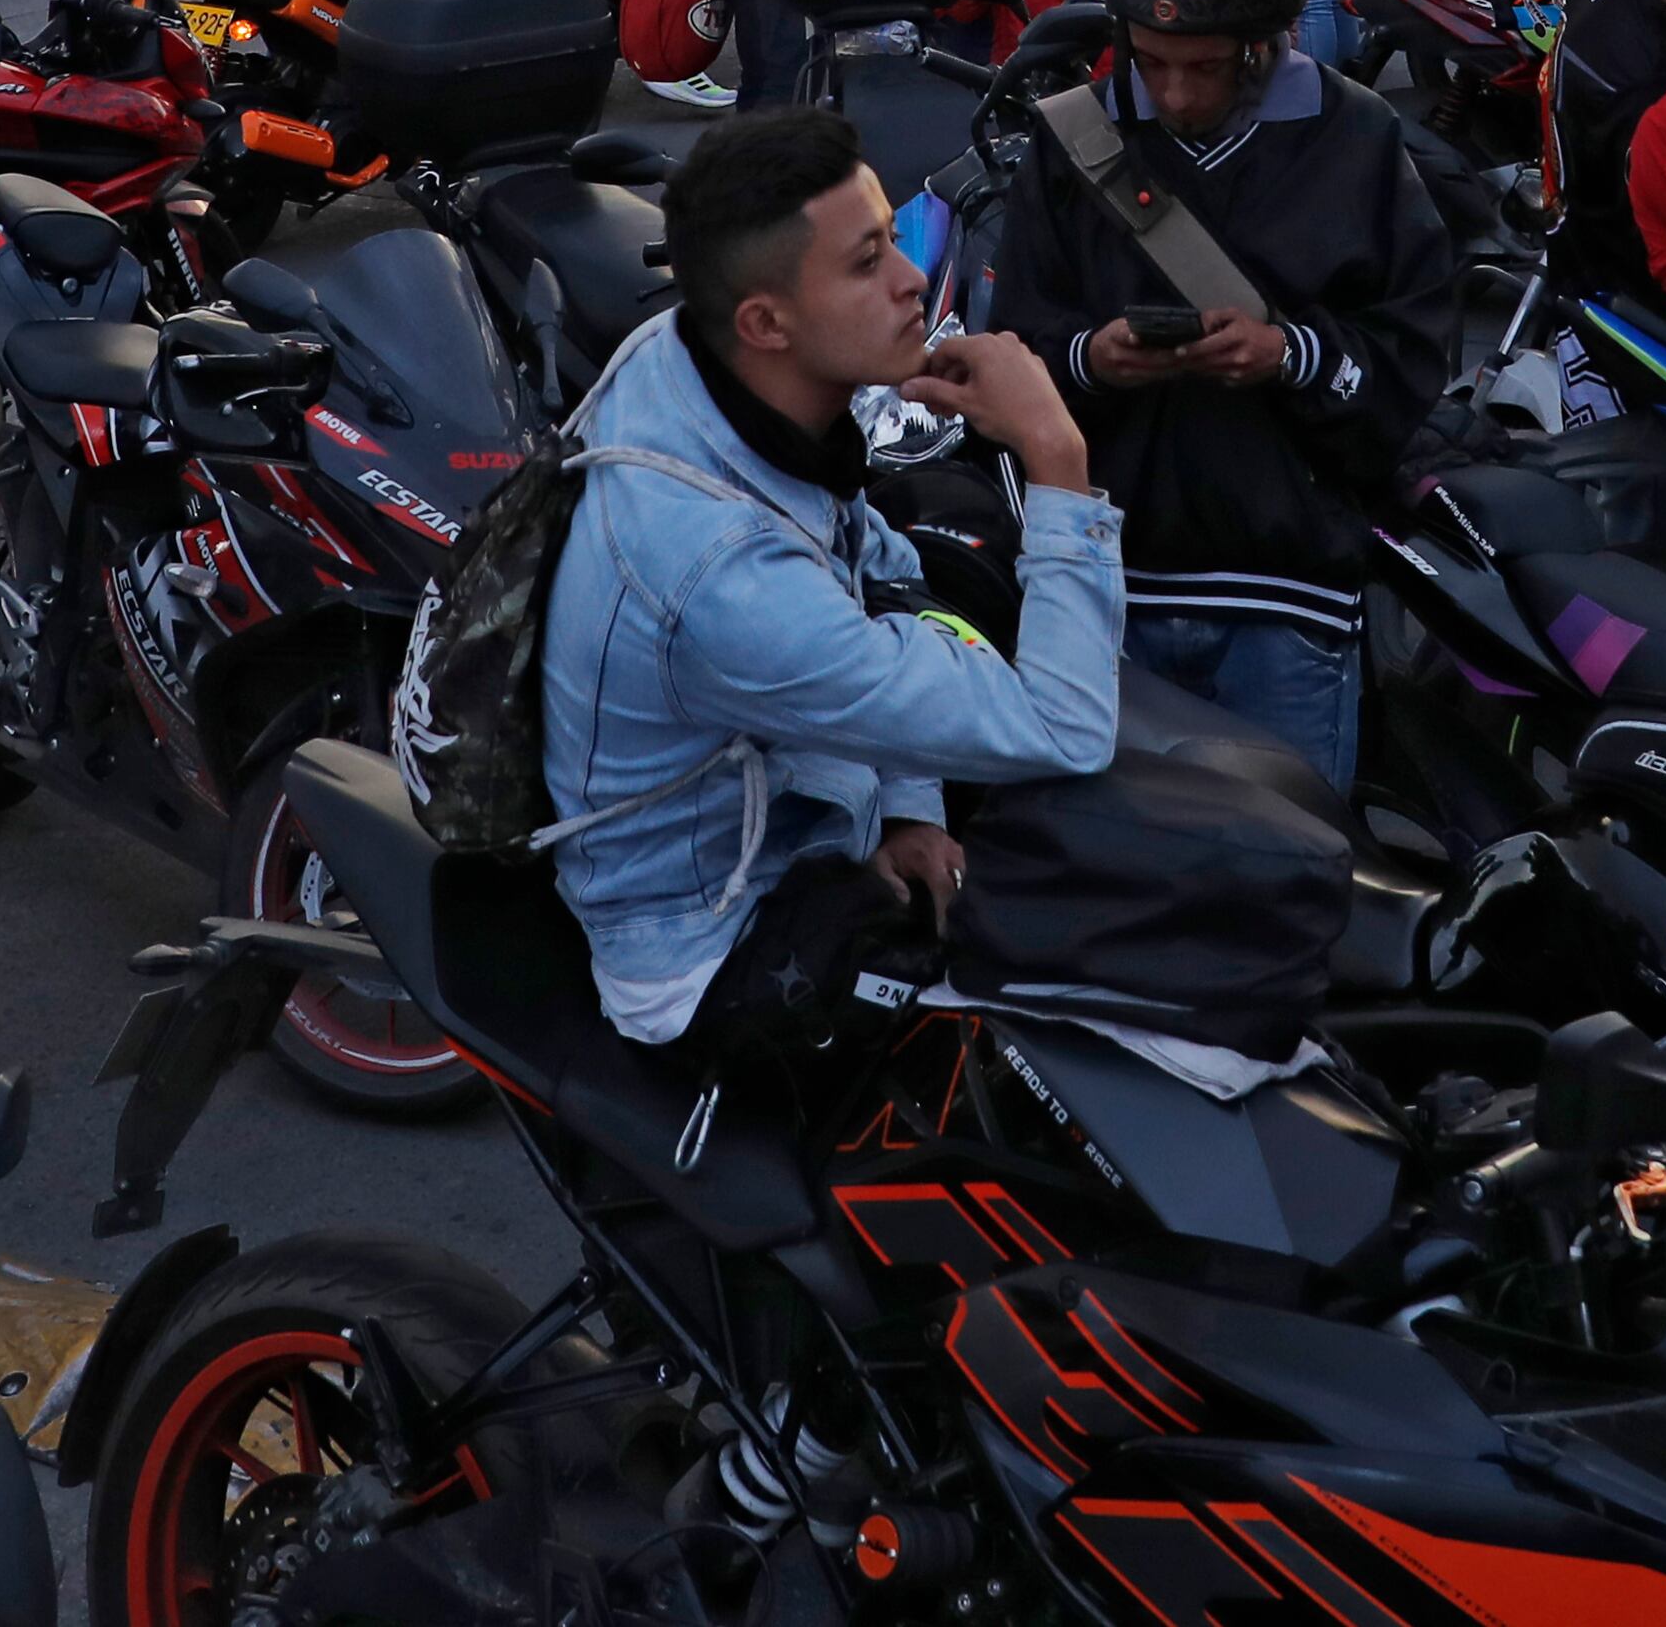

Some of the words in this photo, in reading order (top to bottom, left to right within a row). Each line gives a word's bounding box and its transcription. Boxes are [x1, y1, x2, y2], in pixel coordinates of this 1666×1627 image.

[315, 409, 363, 445] MOTUL
[194, 530, 221, 577] MOTU
[116, 568, 190, 699] ECSTAR
[1003, 1044, 1050, 1102] READY
[1050, 1097, 1069, 1125] TO
[1084, 1141, 1125, 1189] RACE
